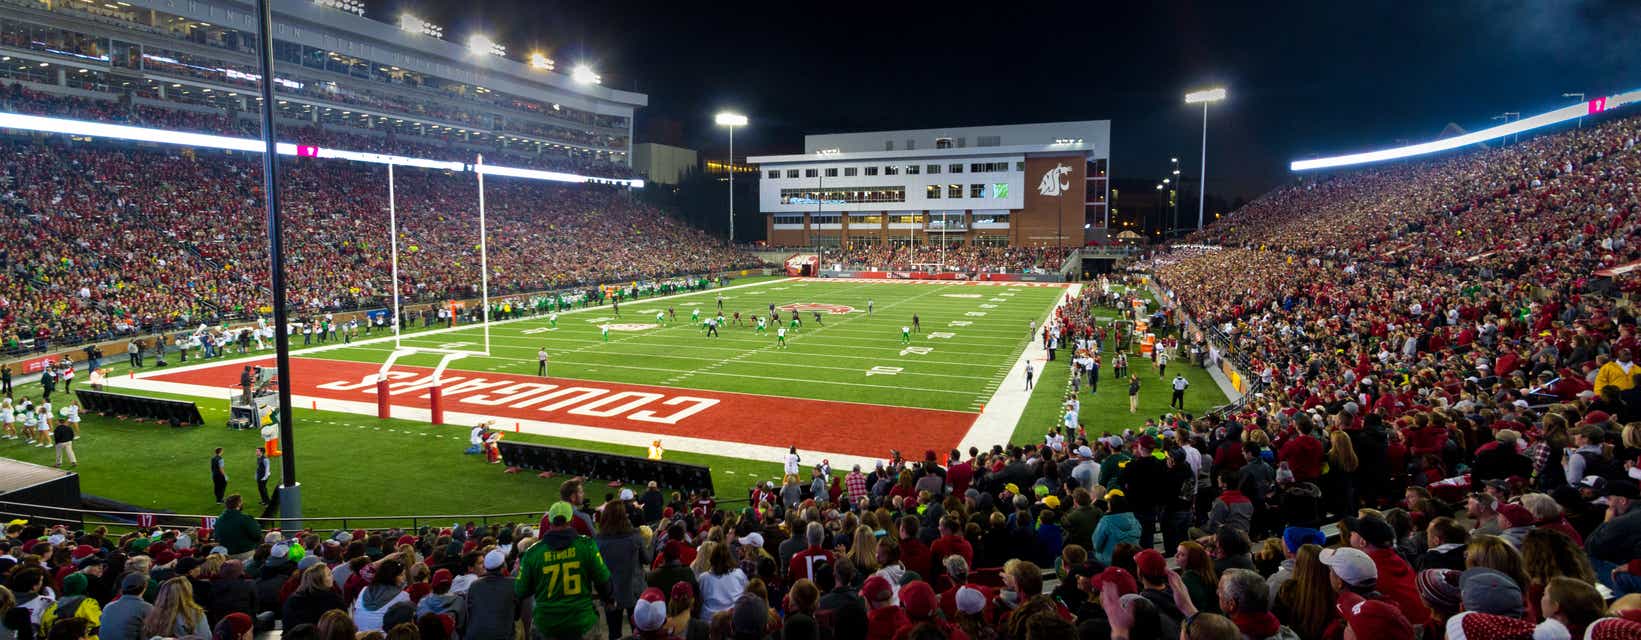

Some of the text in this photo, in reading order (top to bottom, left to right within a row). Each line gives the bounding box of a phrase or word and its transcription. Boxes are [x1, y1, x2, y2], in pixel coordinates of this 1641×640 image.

[316, 370, 721, 425] COUGARS
[141, 514, 153, 528] 17
[542, 561, 582, 599] 76
[804, 554, 828, 583] 1
